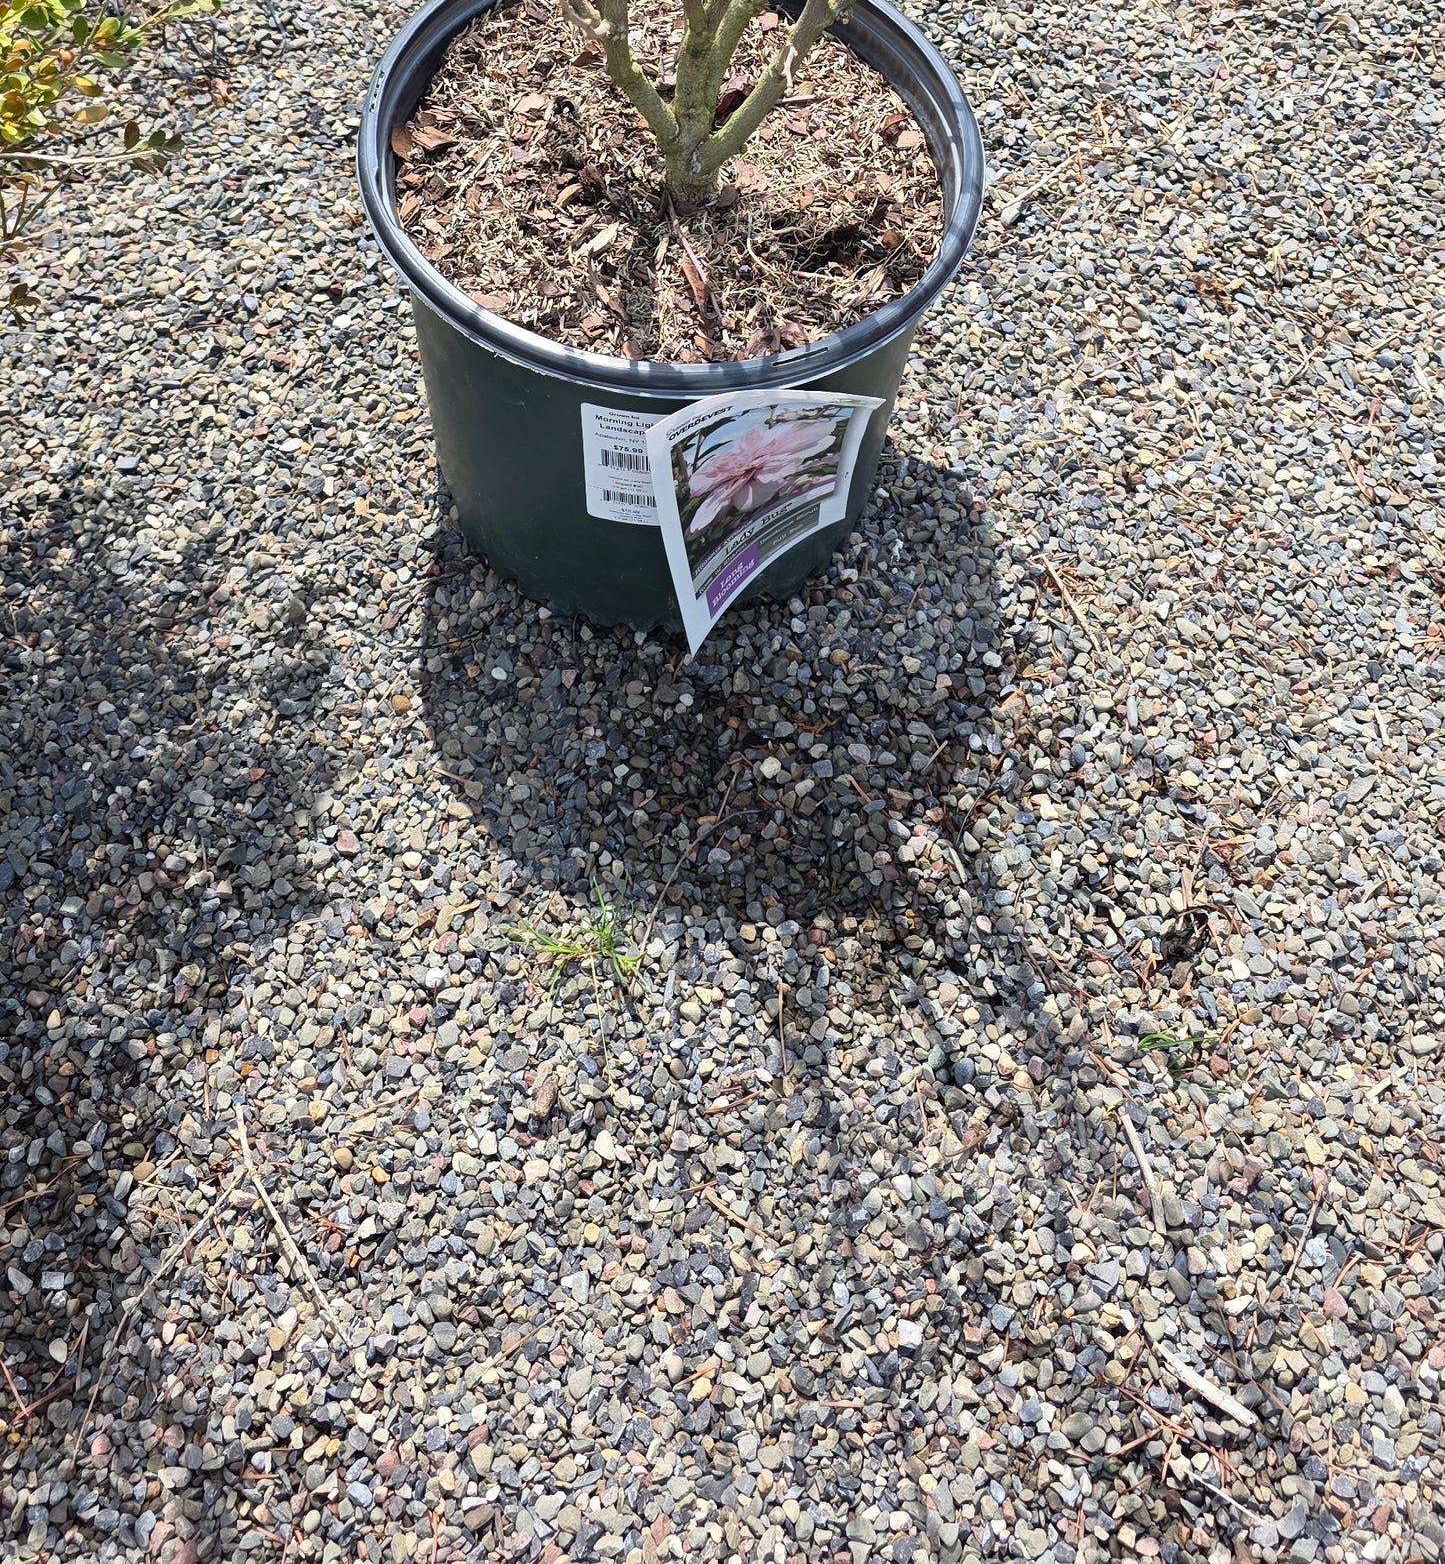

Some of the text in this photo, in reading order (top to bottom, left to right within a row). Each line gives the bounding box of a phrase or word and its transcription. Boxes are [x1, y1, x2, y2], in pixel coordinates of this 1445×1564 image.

[595, 414, 634, 427] Morning
[668, 405, 734, 441] OVERDEVEST
[613, 444, 644, 454] $75.99
[724, 527, 755, 556] Lady
[761, 502, 793, 525] Bug
[712, 558, 755, 608] Long Blooming
